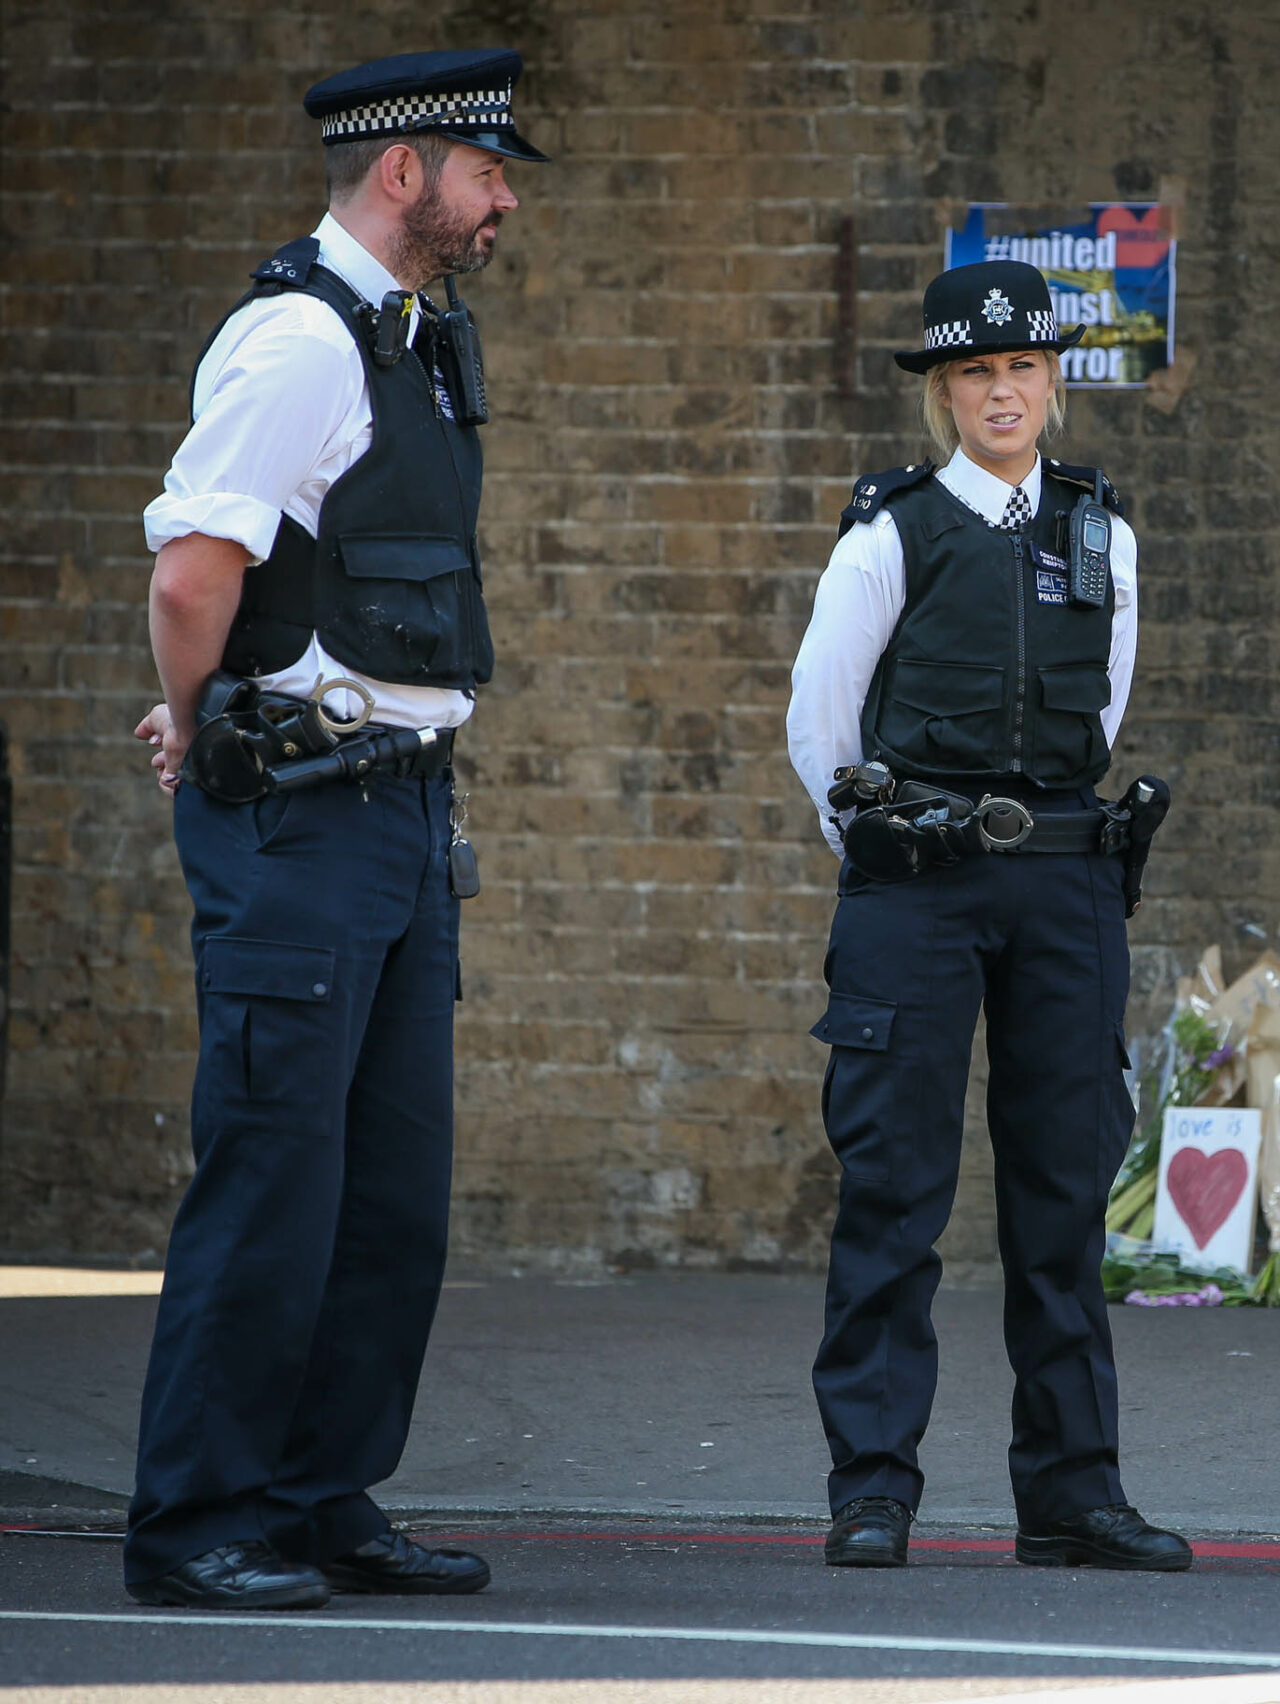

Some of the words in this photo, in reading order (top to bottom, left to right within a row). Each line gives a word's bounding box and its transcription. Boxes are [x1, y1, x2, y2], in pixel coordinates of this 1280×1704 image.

[983, 231, 1117, 270] #united
[1050, 287, 1114, 326] inst
[1060, 346, 1124, 381] rror
[1038, 592, 1064, 603] POLICE
[1169, 1111, 1213, 1140] love
[1228, 1114, 1242, 1136] is
